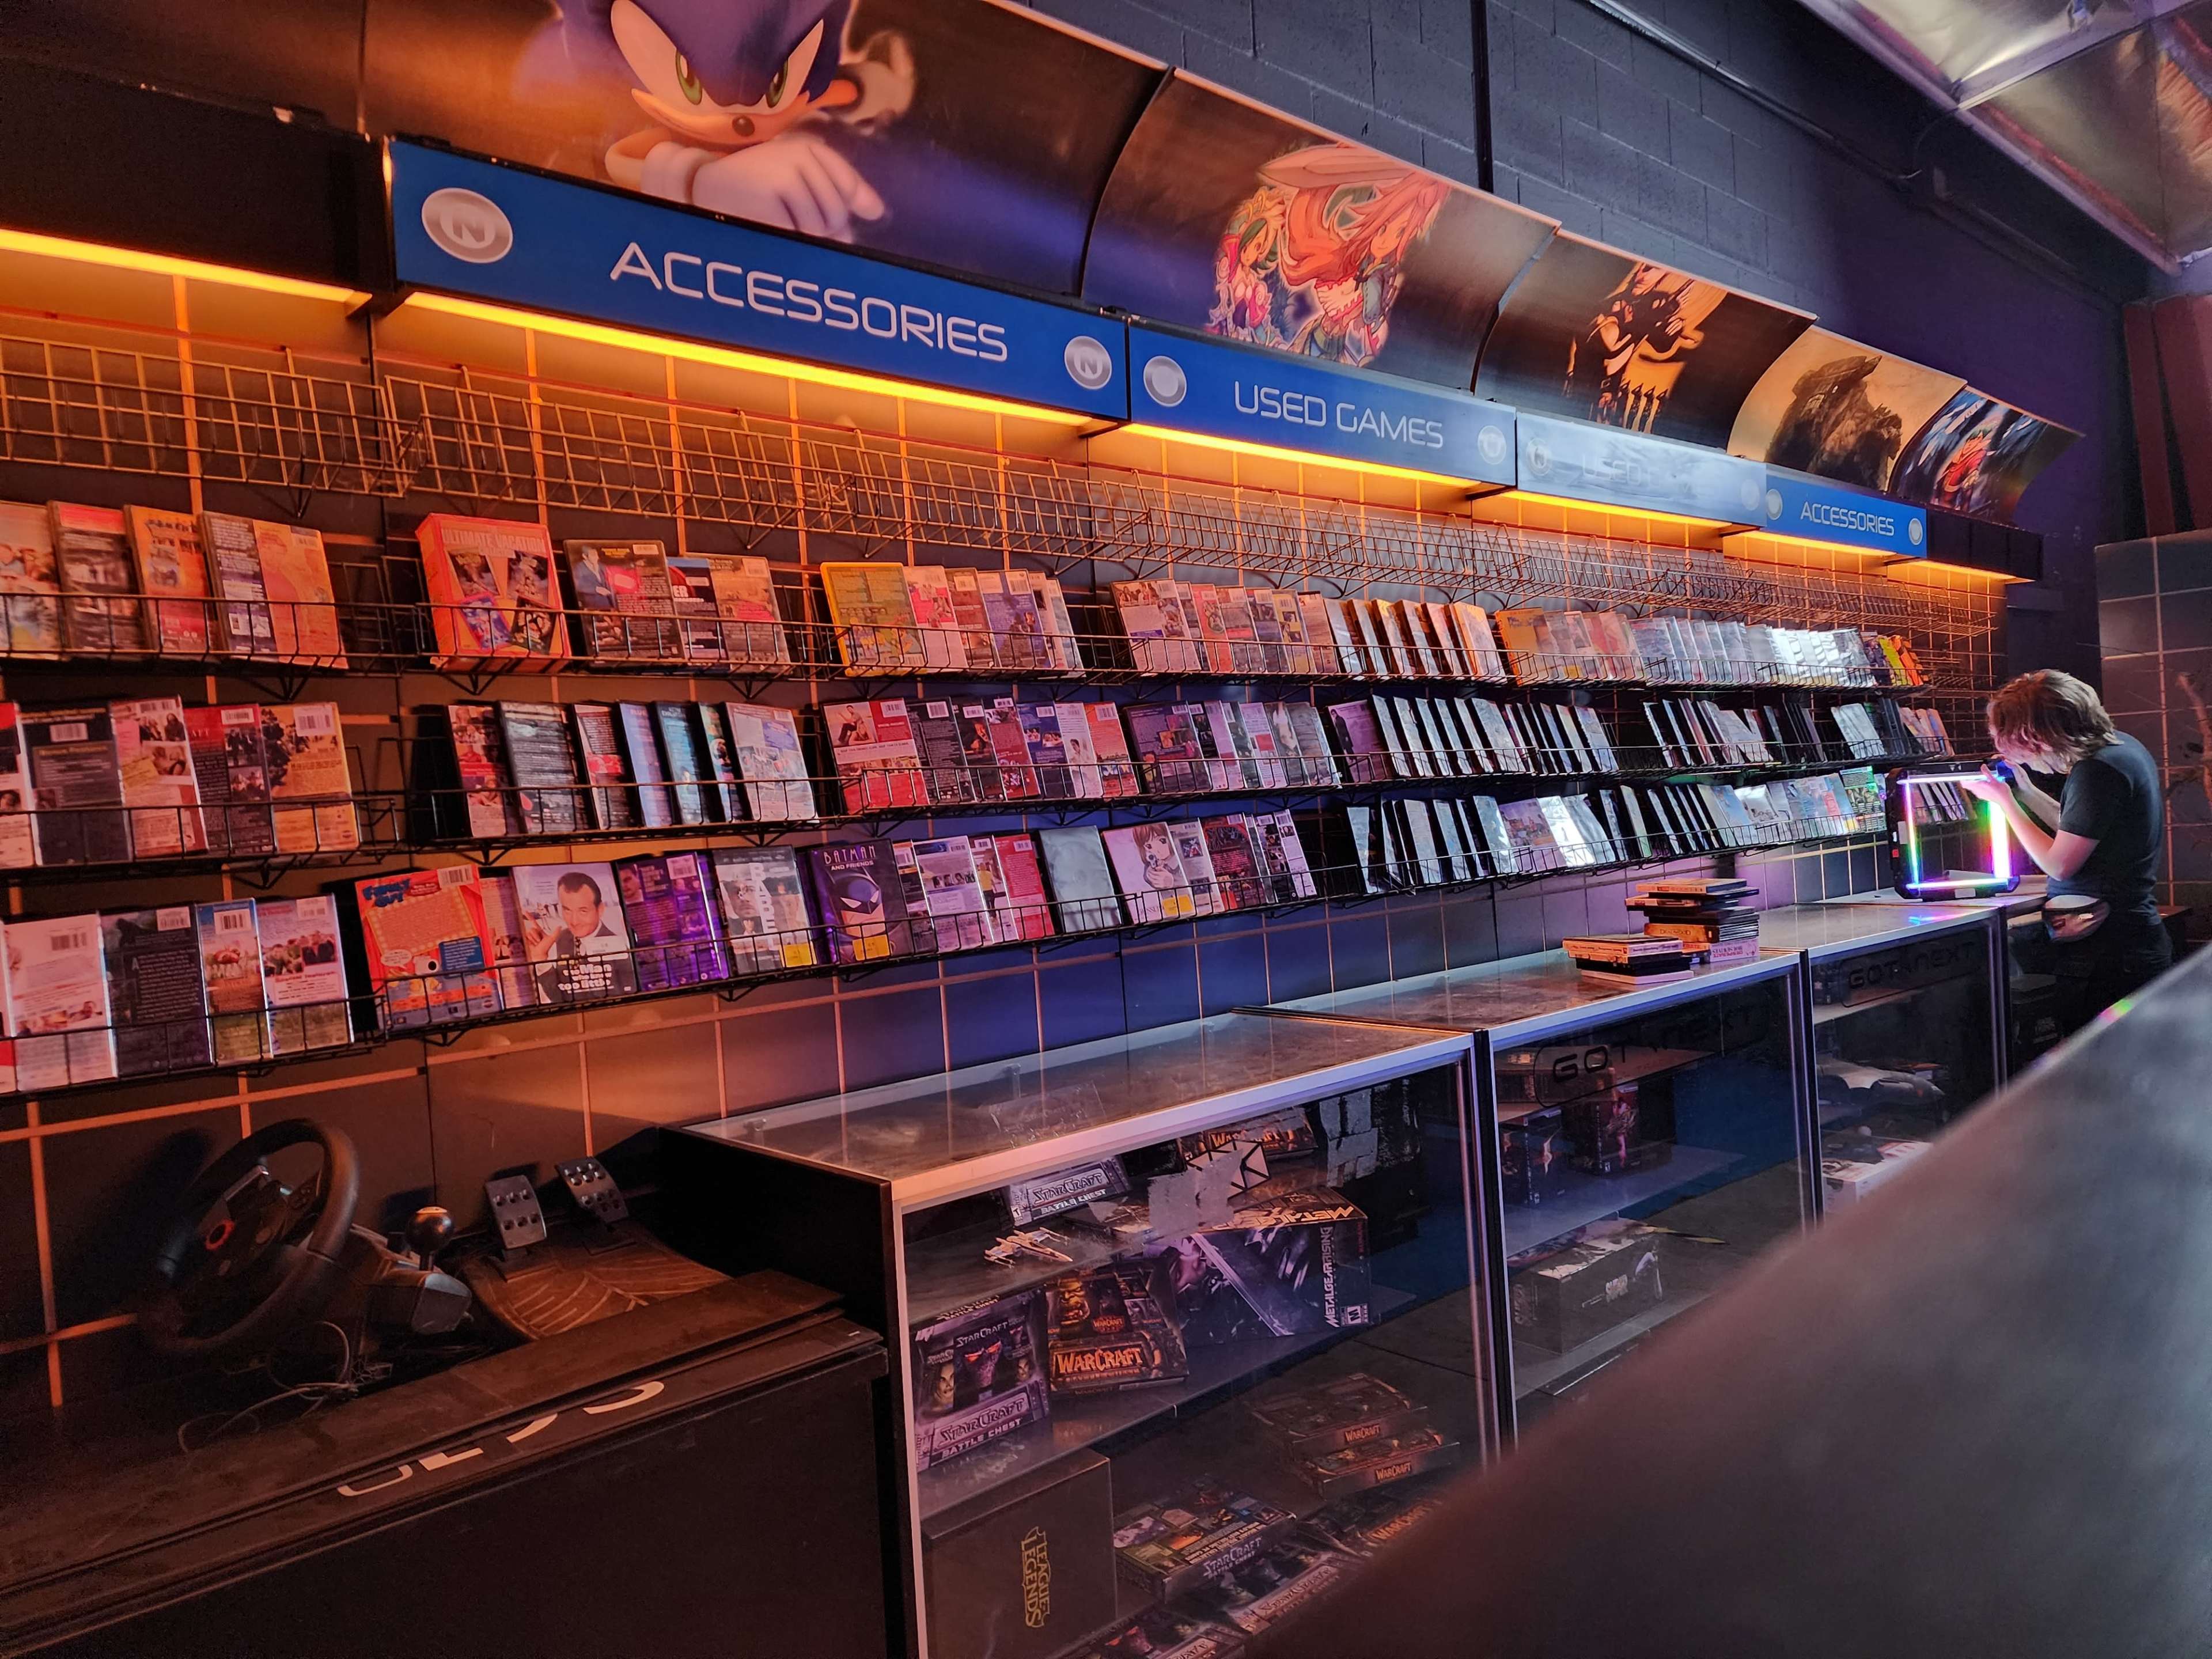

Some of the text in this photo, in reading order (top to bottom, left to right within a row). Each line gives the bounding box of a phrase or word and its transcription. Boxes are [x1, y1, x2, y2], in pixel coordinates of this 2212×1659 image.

[609, 241, 1009, 363] ACCESSORIES
[1234, 380, 1444, 449] USED GAMES
[1800, 501, 1895, 537] ACCESSORIES
[442, 528, 494, 548] ULTIMATE
[823, 845, 876, 865] BATMAN
[846, 860, 874, 869] FRIENDS
[579, 964, 612, 974] Man
[1849, 959, 1900, 989] GOT
[1033, 1173, 1103, 1205] STARCRAFT
[1077, 1189, 1107, 1202] CHEST
[956, 1321, 1008, 1348] STARCRAFT
[1056, 1347, 1143, 1374] WARCRAFT
[939, 1397, 1025, 1448] STARCRAFT
[1344, 1424, 1381, 1442] WARCRAFT
[941, 1434, 984, 1459] BATTLE
[987, 1418, 1022, 1438] CHEST
[1374, 1461, 1412, 1482] WARCRAFT
[1203, 1536, 1263, 1577] STARCRAFT
[1021, 1533, 1043, 1628] LEGENDS
[1036, 1540, 1051, 1612] LEAGUE
